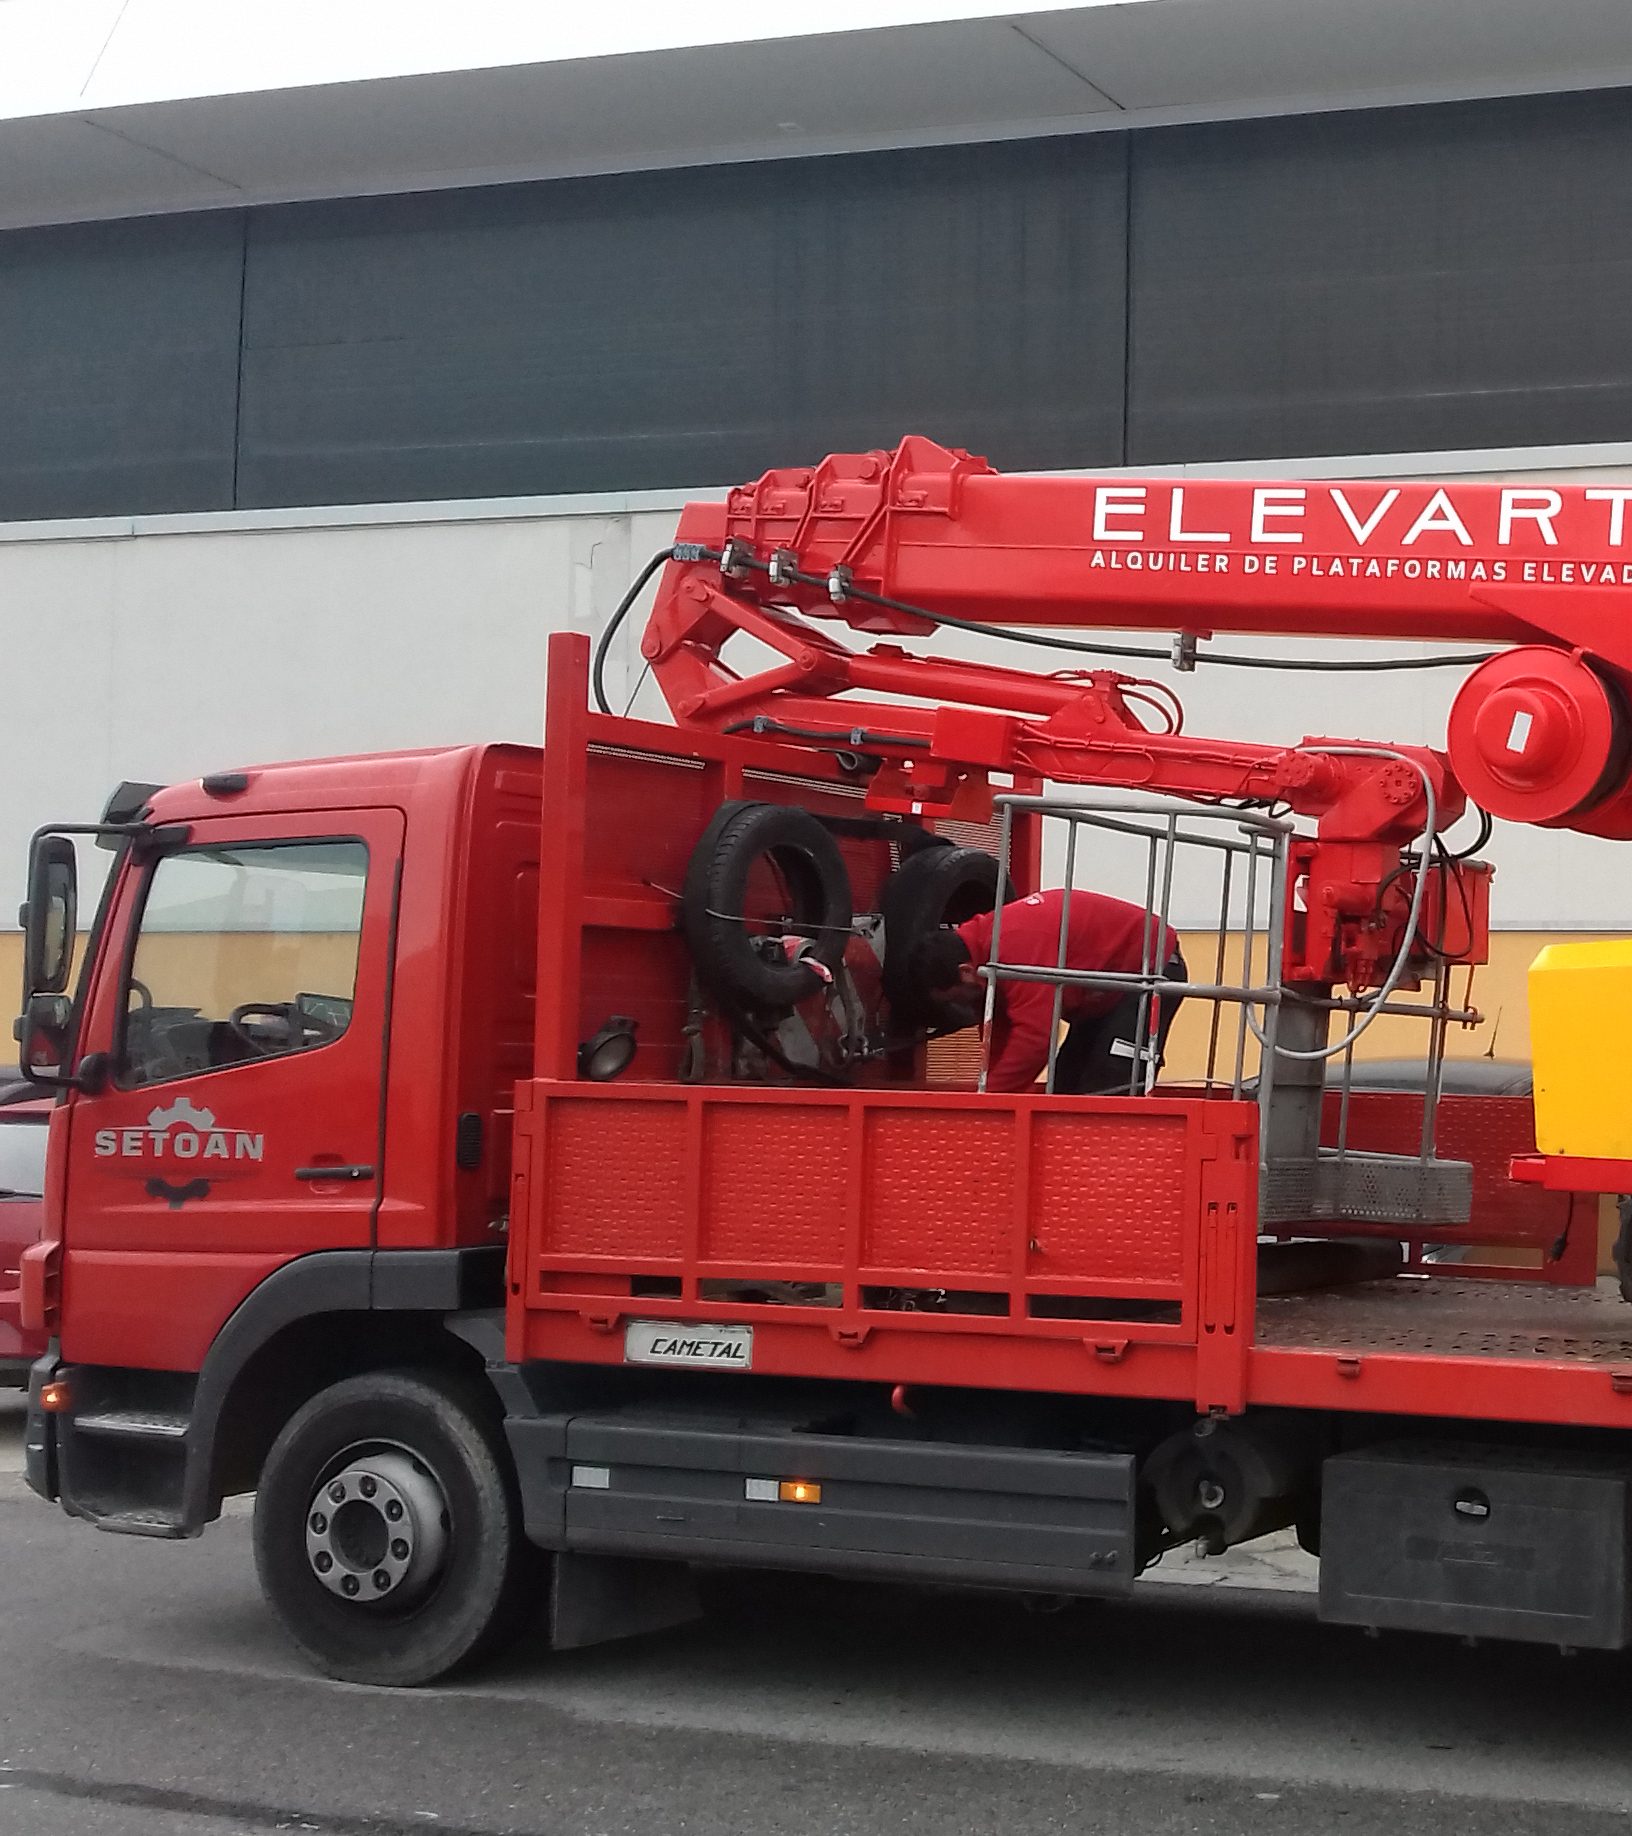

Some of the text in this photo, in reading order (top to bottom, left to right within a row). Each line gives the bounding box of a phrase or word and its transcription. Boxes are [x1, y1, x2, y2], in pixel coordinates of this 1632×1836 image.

[1090, 550, 1229, 573] ALQUILER
[1244, 555, 1279, 575] DE
[1292, 556, 1507, 581] PLATAFORMAS
[95, 1130, 264, 1160] SETOAN
[649, 1338, 746, 1359] CAMETAL
